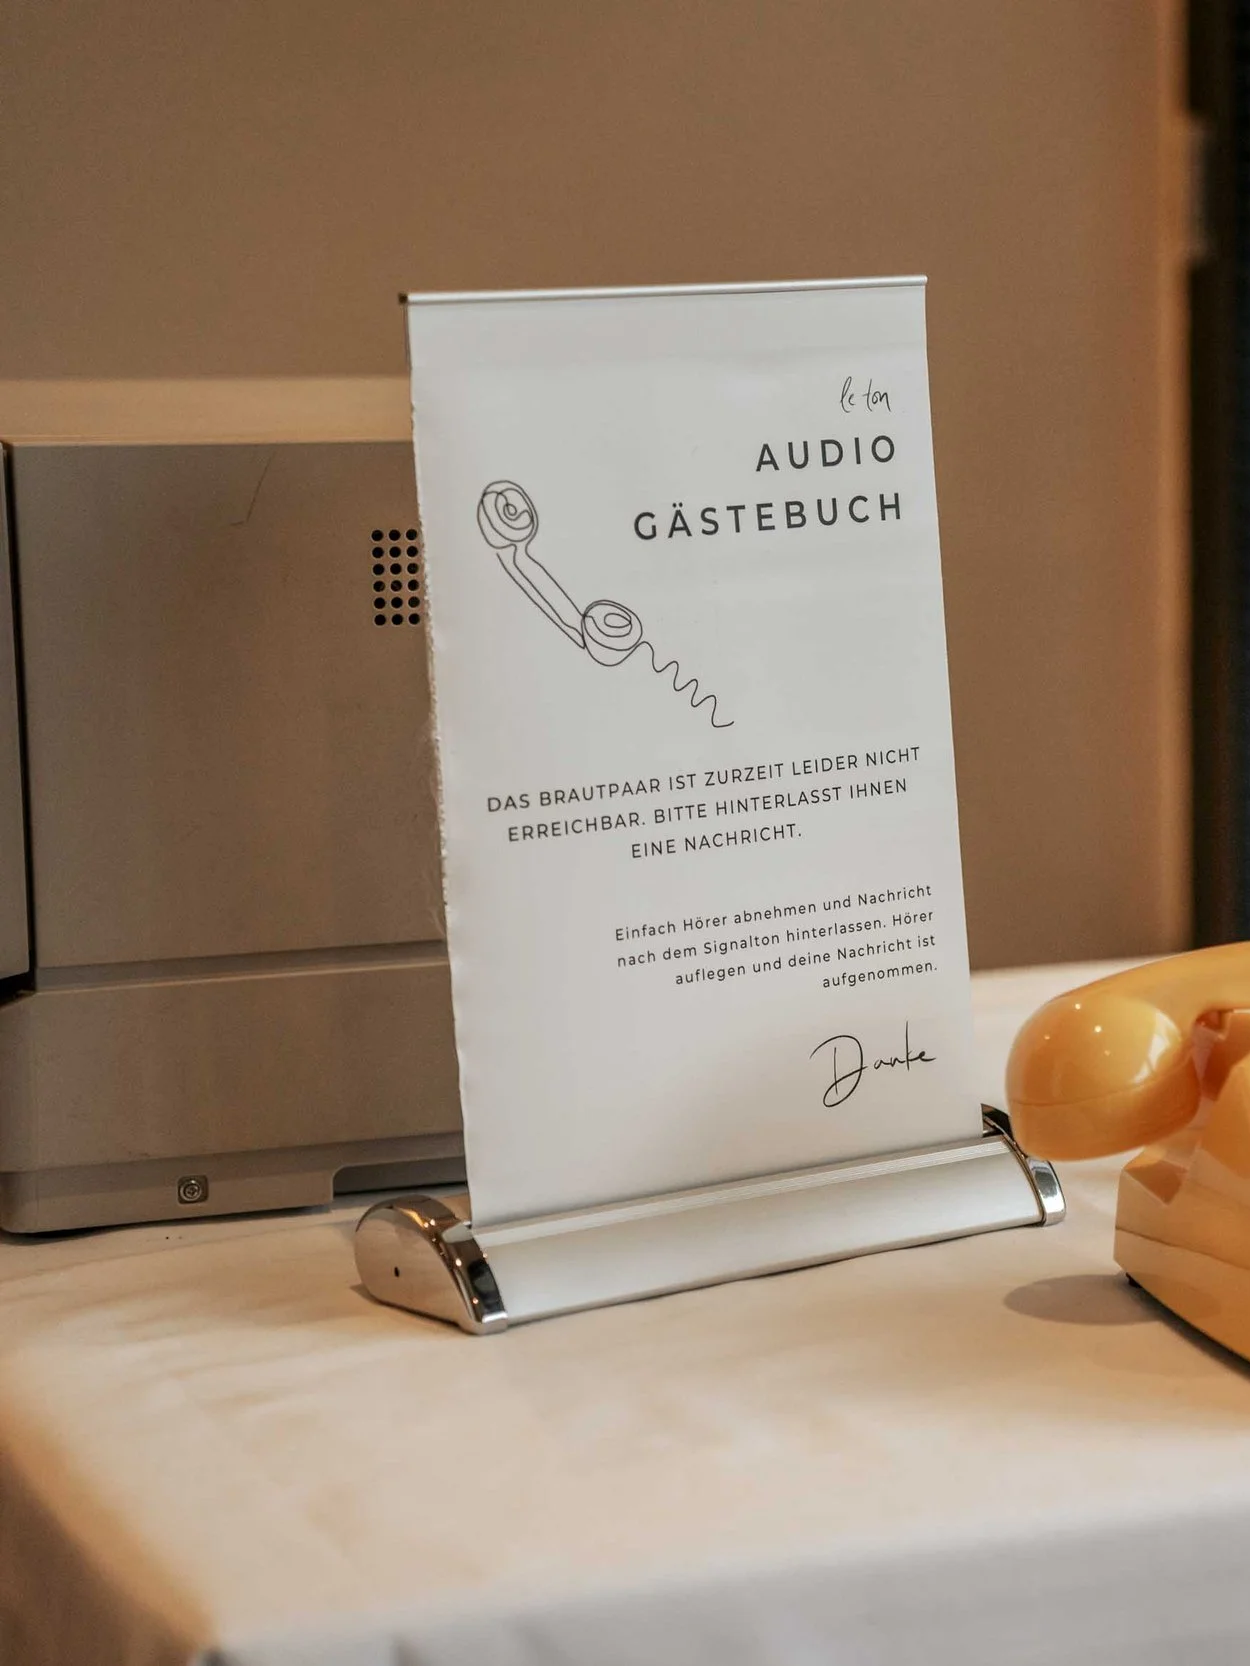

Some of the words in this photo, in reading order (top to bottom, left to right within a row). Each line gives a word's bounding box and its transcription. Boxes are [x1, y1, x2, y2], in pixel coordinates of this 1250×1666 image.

[840, 376, 856, 413] le
[862, 379, 891, 412] ton
[756, 435, 895, 472] AUDIO
[634, 492, 900, 540] GÄSTEBUCH
[488, 794, 530, 812] DAS
[540, 778, 660, 806] BRAUTPAAR
[669, 773, 696, 791] IST
[704, 763, 783, 786] ZURZEIT
[792, 755, 857, 776] LEIDER
[866, 747, 920, 767] NICHT
[508, 812, 645, 842] ERREICHBAR.
[654, 803, 707, 824] BITTE
[716, 786, 842, 816] HINTERLASST
[850, 778, 906, 799] IHNEN
[632, 839, 676, 858] EINE
[685, 823, 801, 852] NACHRICHT.
[616, 921, 676, 941] Einfach
[683, 916, 727, 931] Hörer
[734, 904, 816, 924] abnehmen
[823, 895, 851, 911] und
[858, 885, 931, 906] Nachricht
[618, 950, 655, 967] nach
[663, 947, 697, 960] dem
[704, 934, 779, 955] Signalton
[786, 920, 887, 942] hinterlassen.
[893, 912, 933, 927] Hörer
[676, 966, 745, 985] auflegen
[753, 956, 781, 973] und
[788, 952, 831, 967] deine
[837, 938, 912, 960] Nachricht
[918, 935, 935, 948] ist
[823, 962, 937, 988] aufgenommen.
[810, 1021, 936, 1108] Danke
